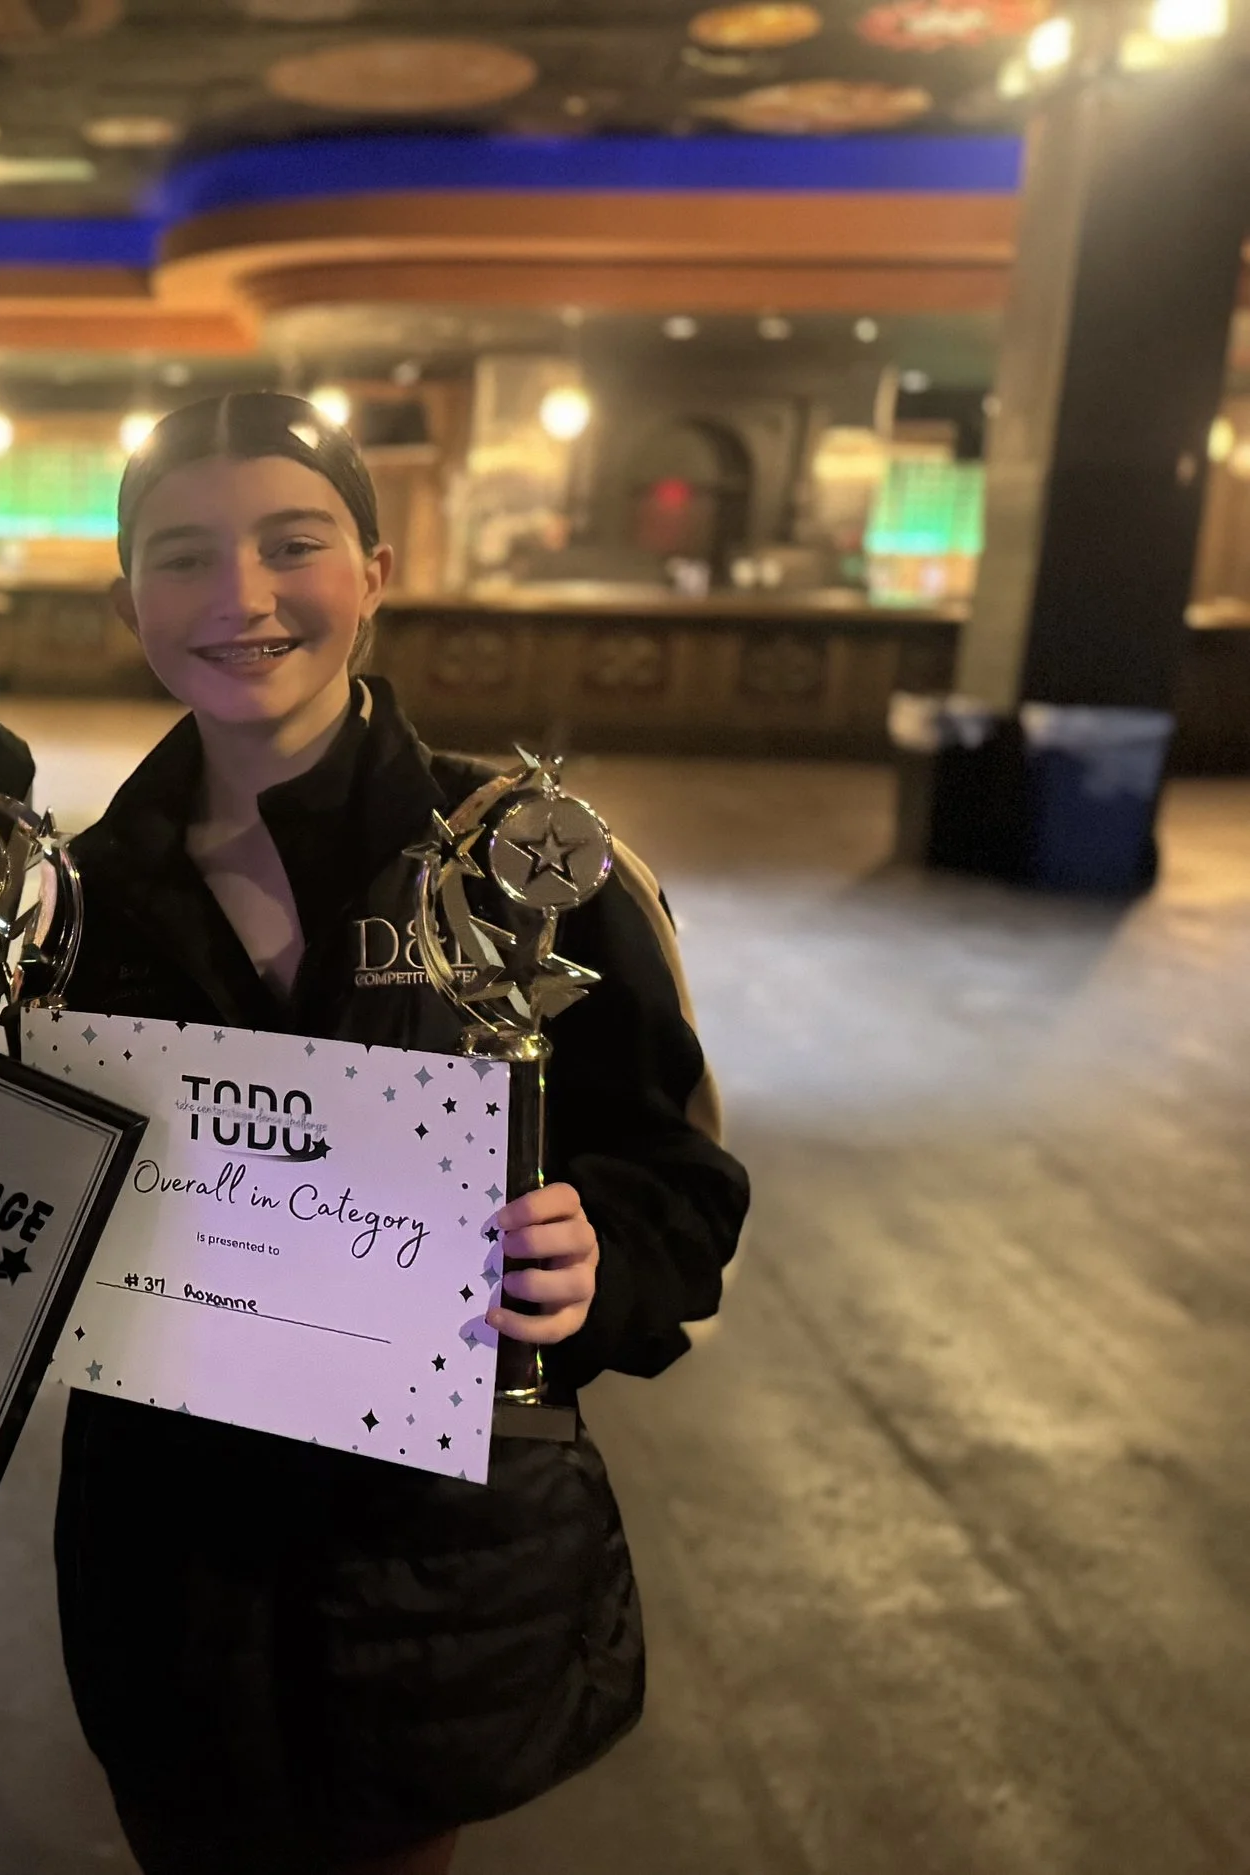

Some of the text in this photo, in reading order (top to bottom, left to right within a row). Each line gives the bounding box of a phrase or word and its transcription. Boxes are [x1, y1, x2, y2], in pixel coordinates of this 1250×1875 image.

[181, 1074, 313, 1157] TODO
[133, 1159, 431, 1269] Overall in Category
[208, 1235, 265, 1253] presented
[268, 1245, 280, 1256] to
[183, 1283, 258, 1314] Roxanne
